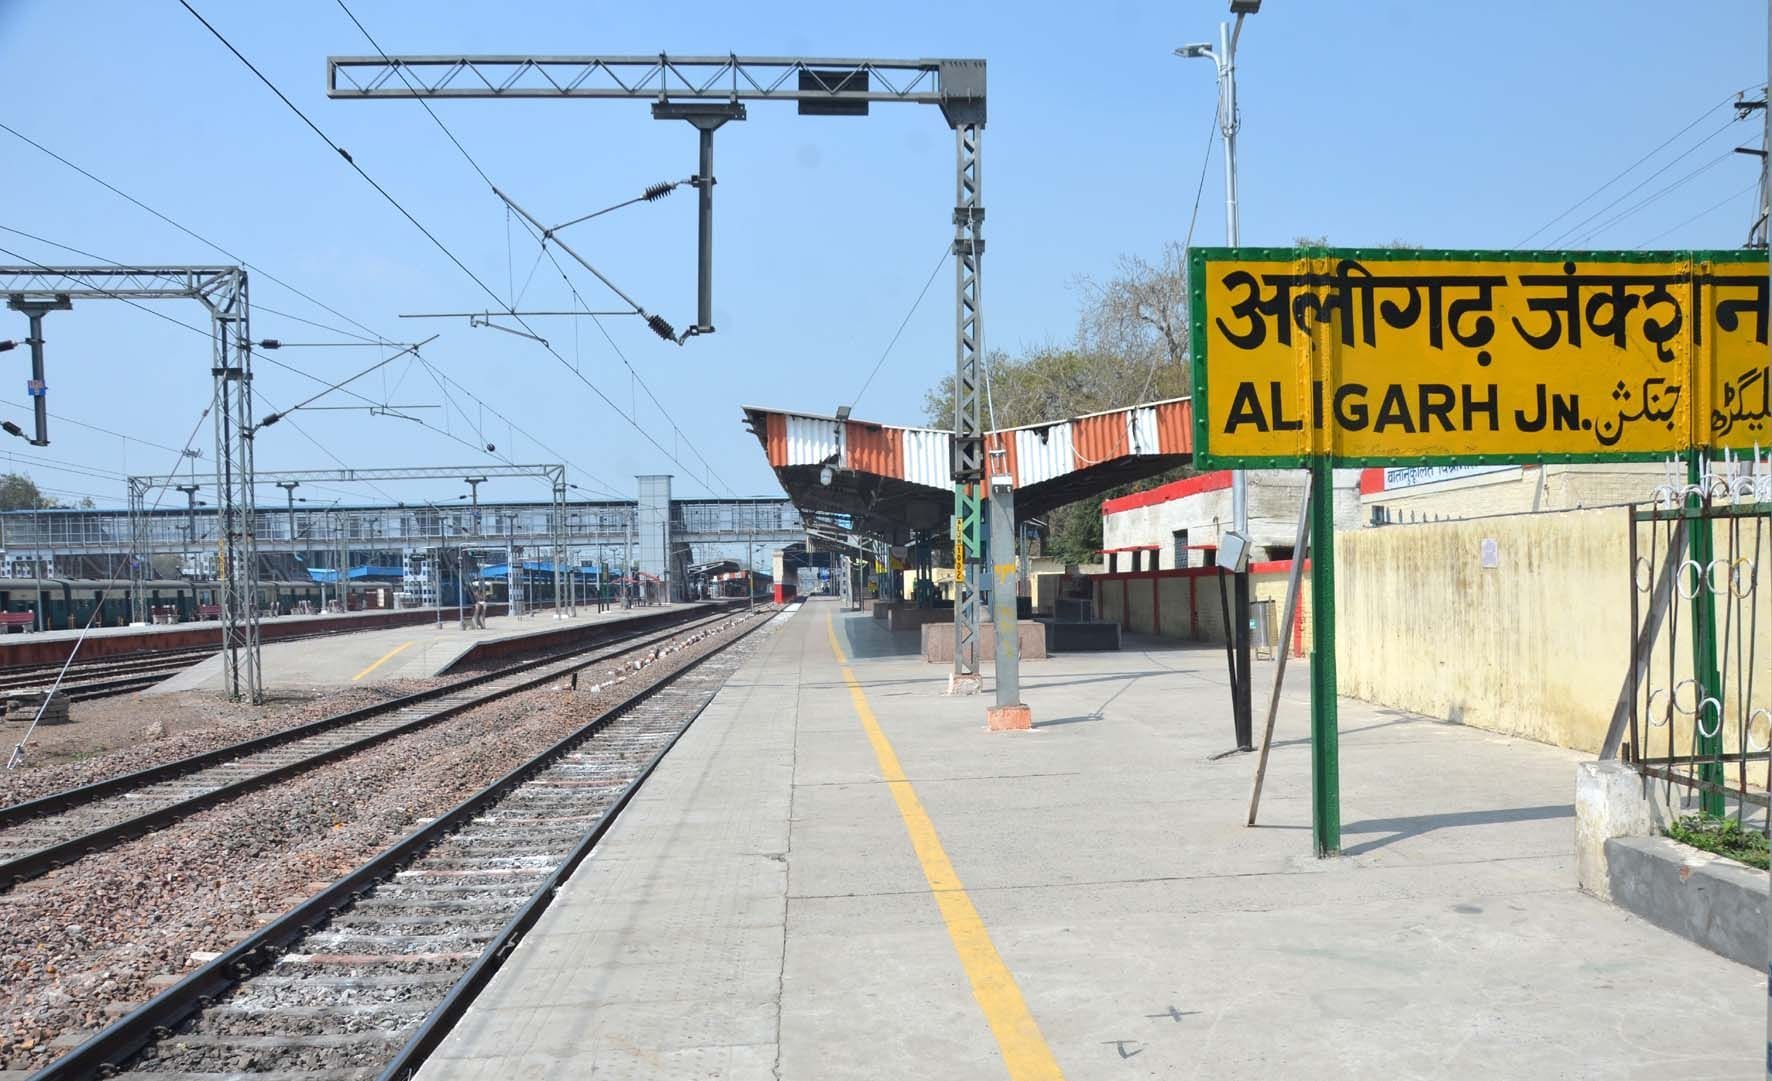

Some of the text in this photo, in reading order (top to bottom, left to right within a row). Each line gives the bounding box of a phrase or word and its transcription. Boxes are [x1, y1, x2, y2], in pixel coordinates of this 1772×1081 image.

[1216, 260, 1507, 367] अलीगढ़
[1224, 381, 1592, 433] ALIGARH JN.
[1595, 366, 1769, 446] لیگڑھ جنکشن
